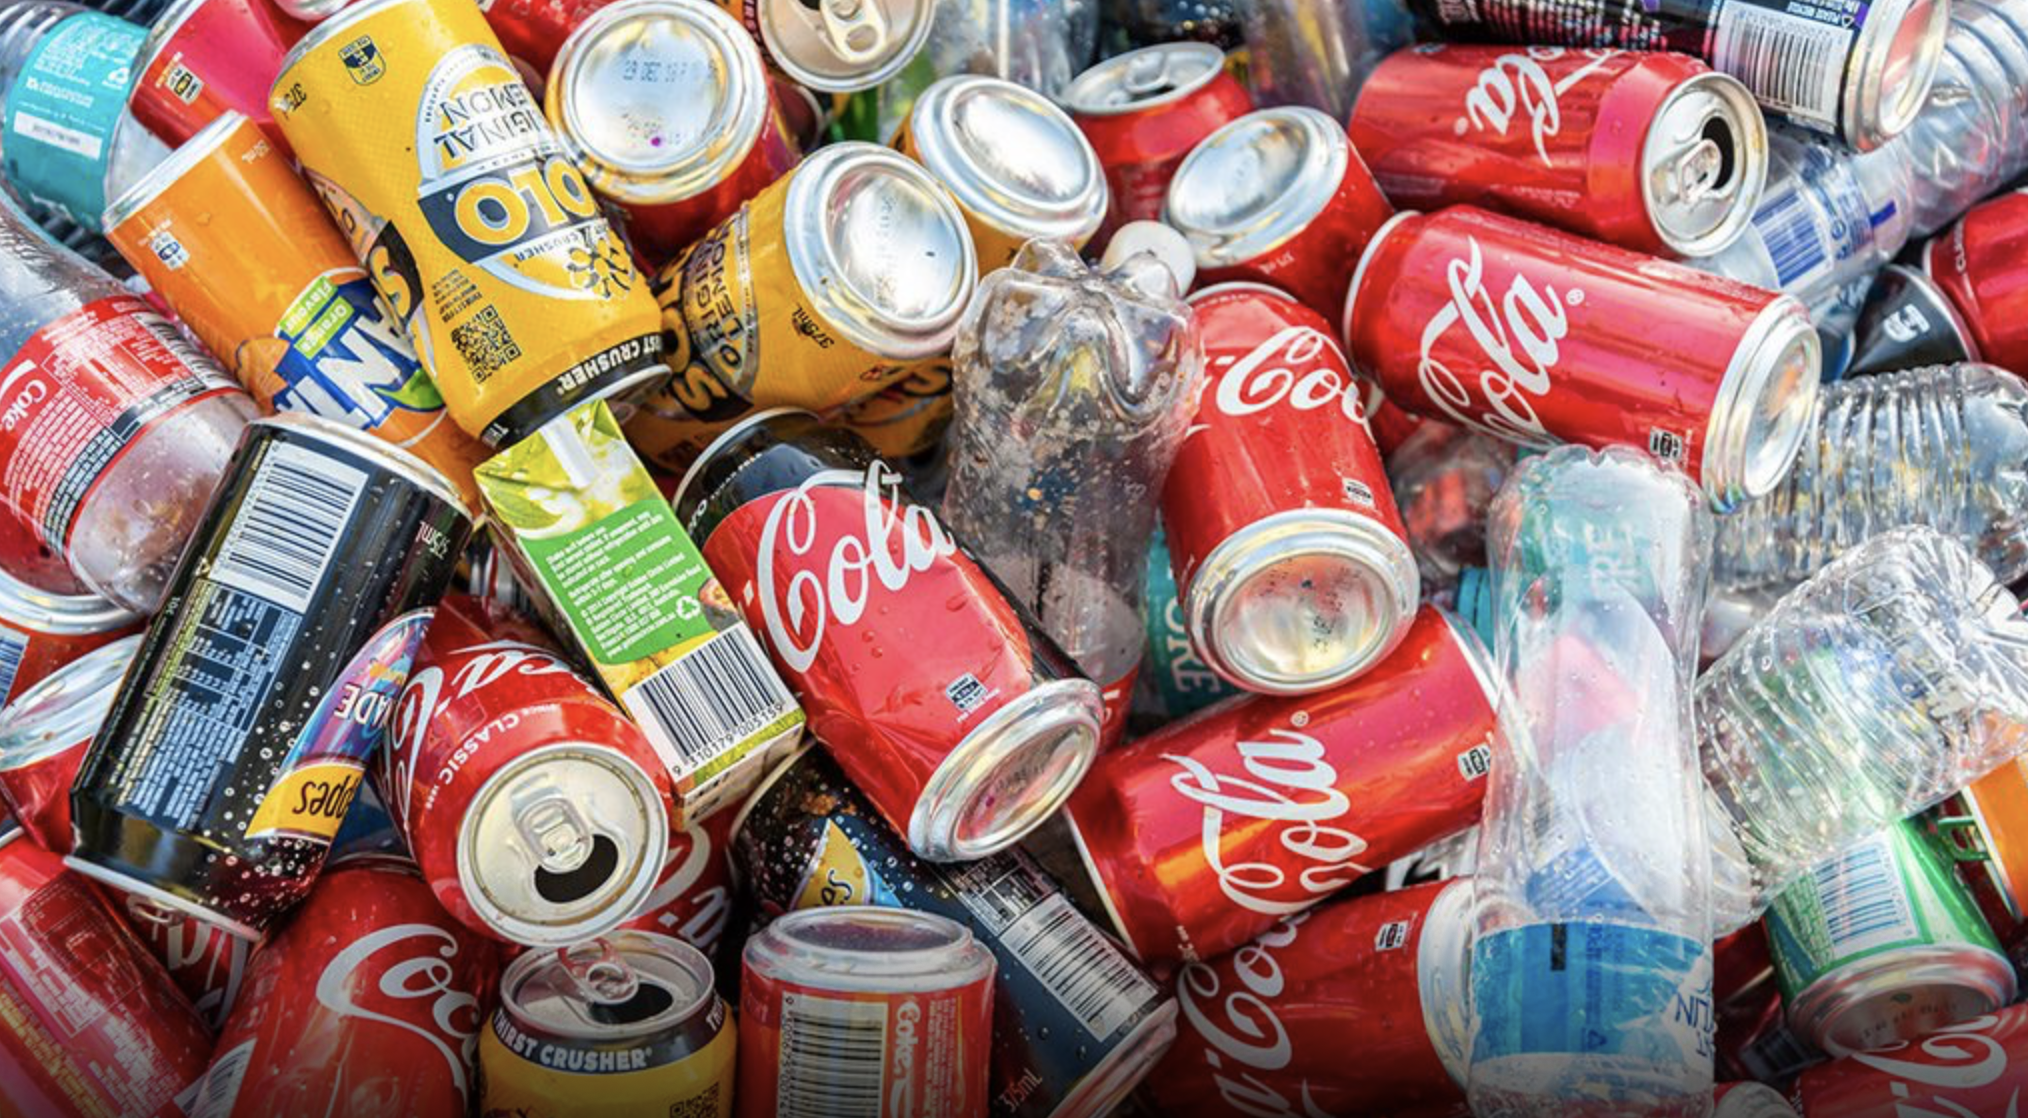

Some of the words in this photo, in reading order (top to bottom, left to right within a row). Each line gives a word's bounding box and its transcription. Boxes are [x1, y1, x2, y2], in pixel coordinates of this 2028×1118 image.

[282, 281, 332, 333] Flavour
[297, 303, 349, 352] Orange
[0, 378, 48, 431] Coke
[437, 712, 520, 785] CLASSIC
[493, 1008, 538, 1058] THIRST
[539, 1043, 646, 1072] CRUSHER
[997, 1067, 1043, 1113] 375mL
